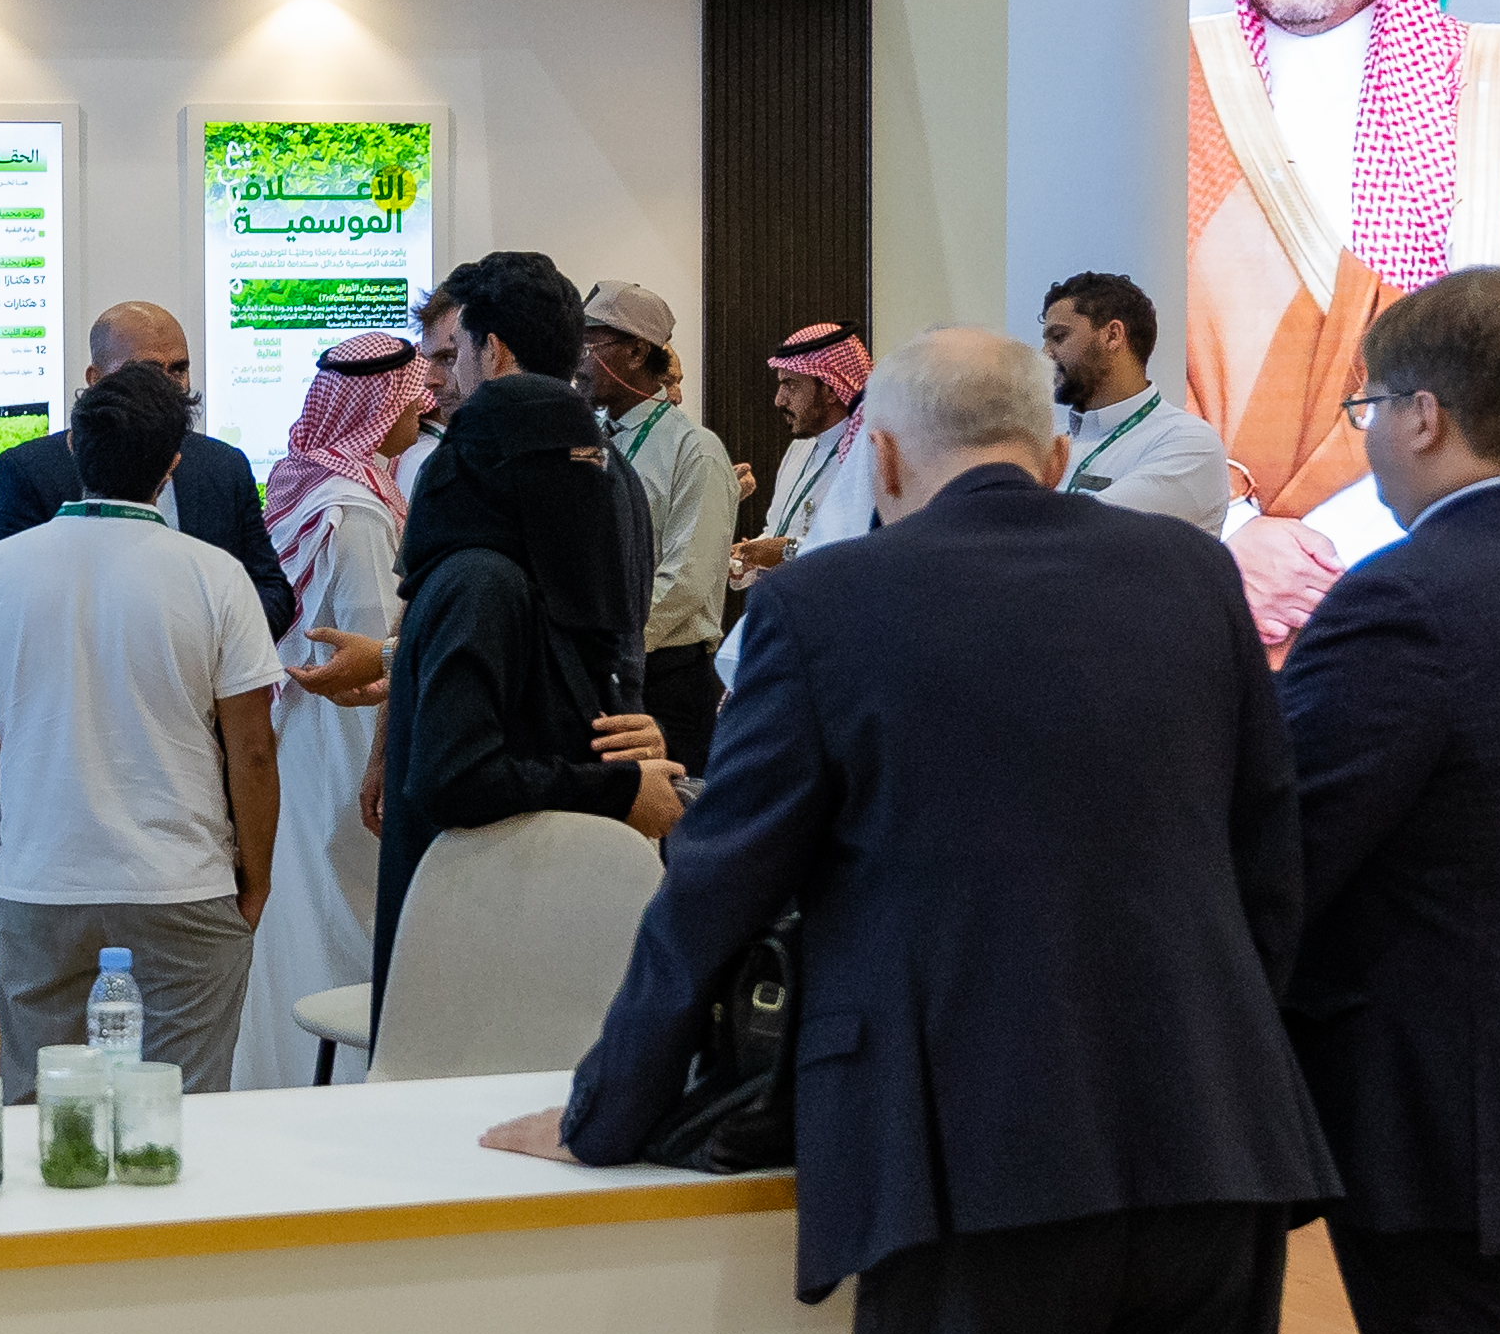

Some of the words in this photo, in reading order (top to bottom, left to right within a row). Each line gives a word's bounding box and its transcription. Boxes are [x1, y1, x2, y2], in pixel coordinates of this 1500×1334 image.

[232, 170, 404, 201] الأعلاف
[234, 207, 401, 242] الموسمية
[33, 276, 45, 284] 57
[40, 299, 45, 307] 3
[36, 346, 46, 354] 12
[38, 367, 44, 375] 3
